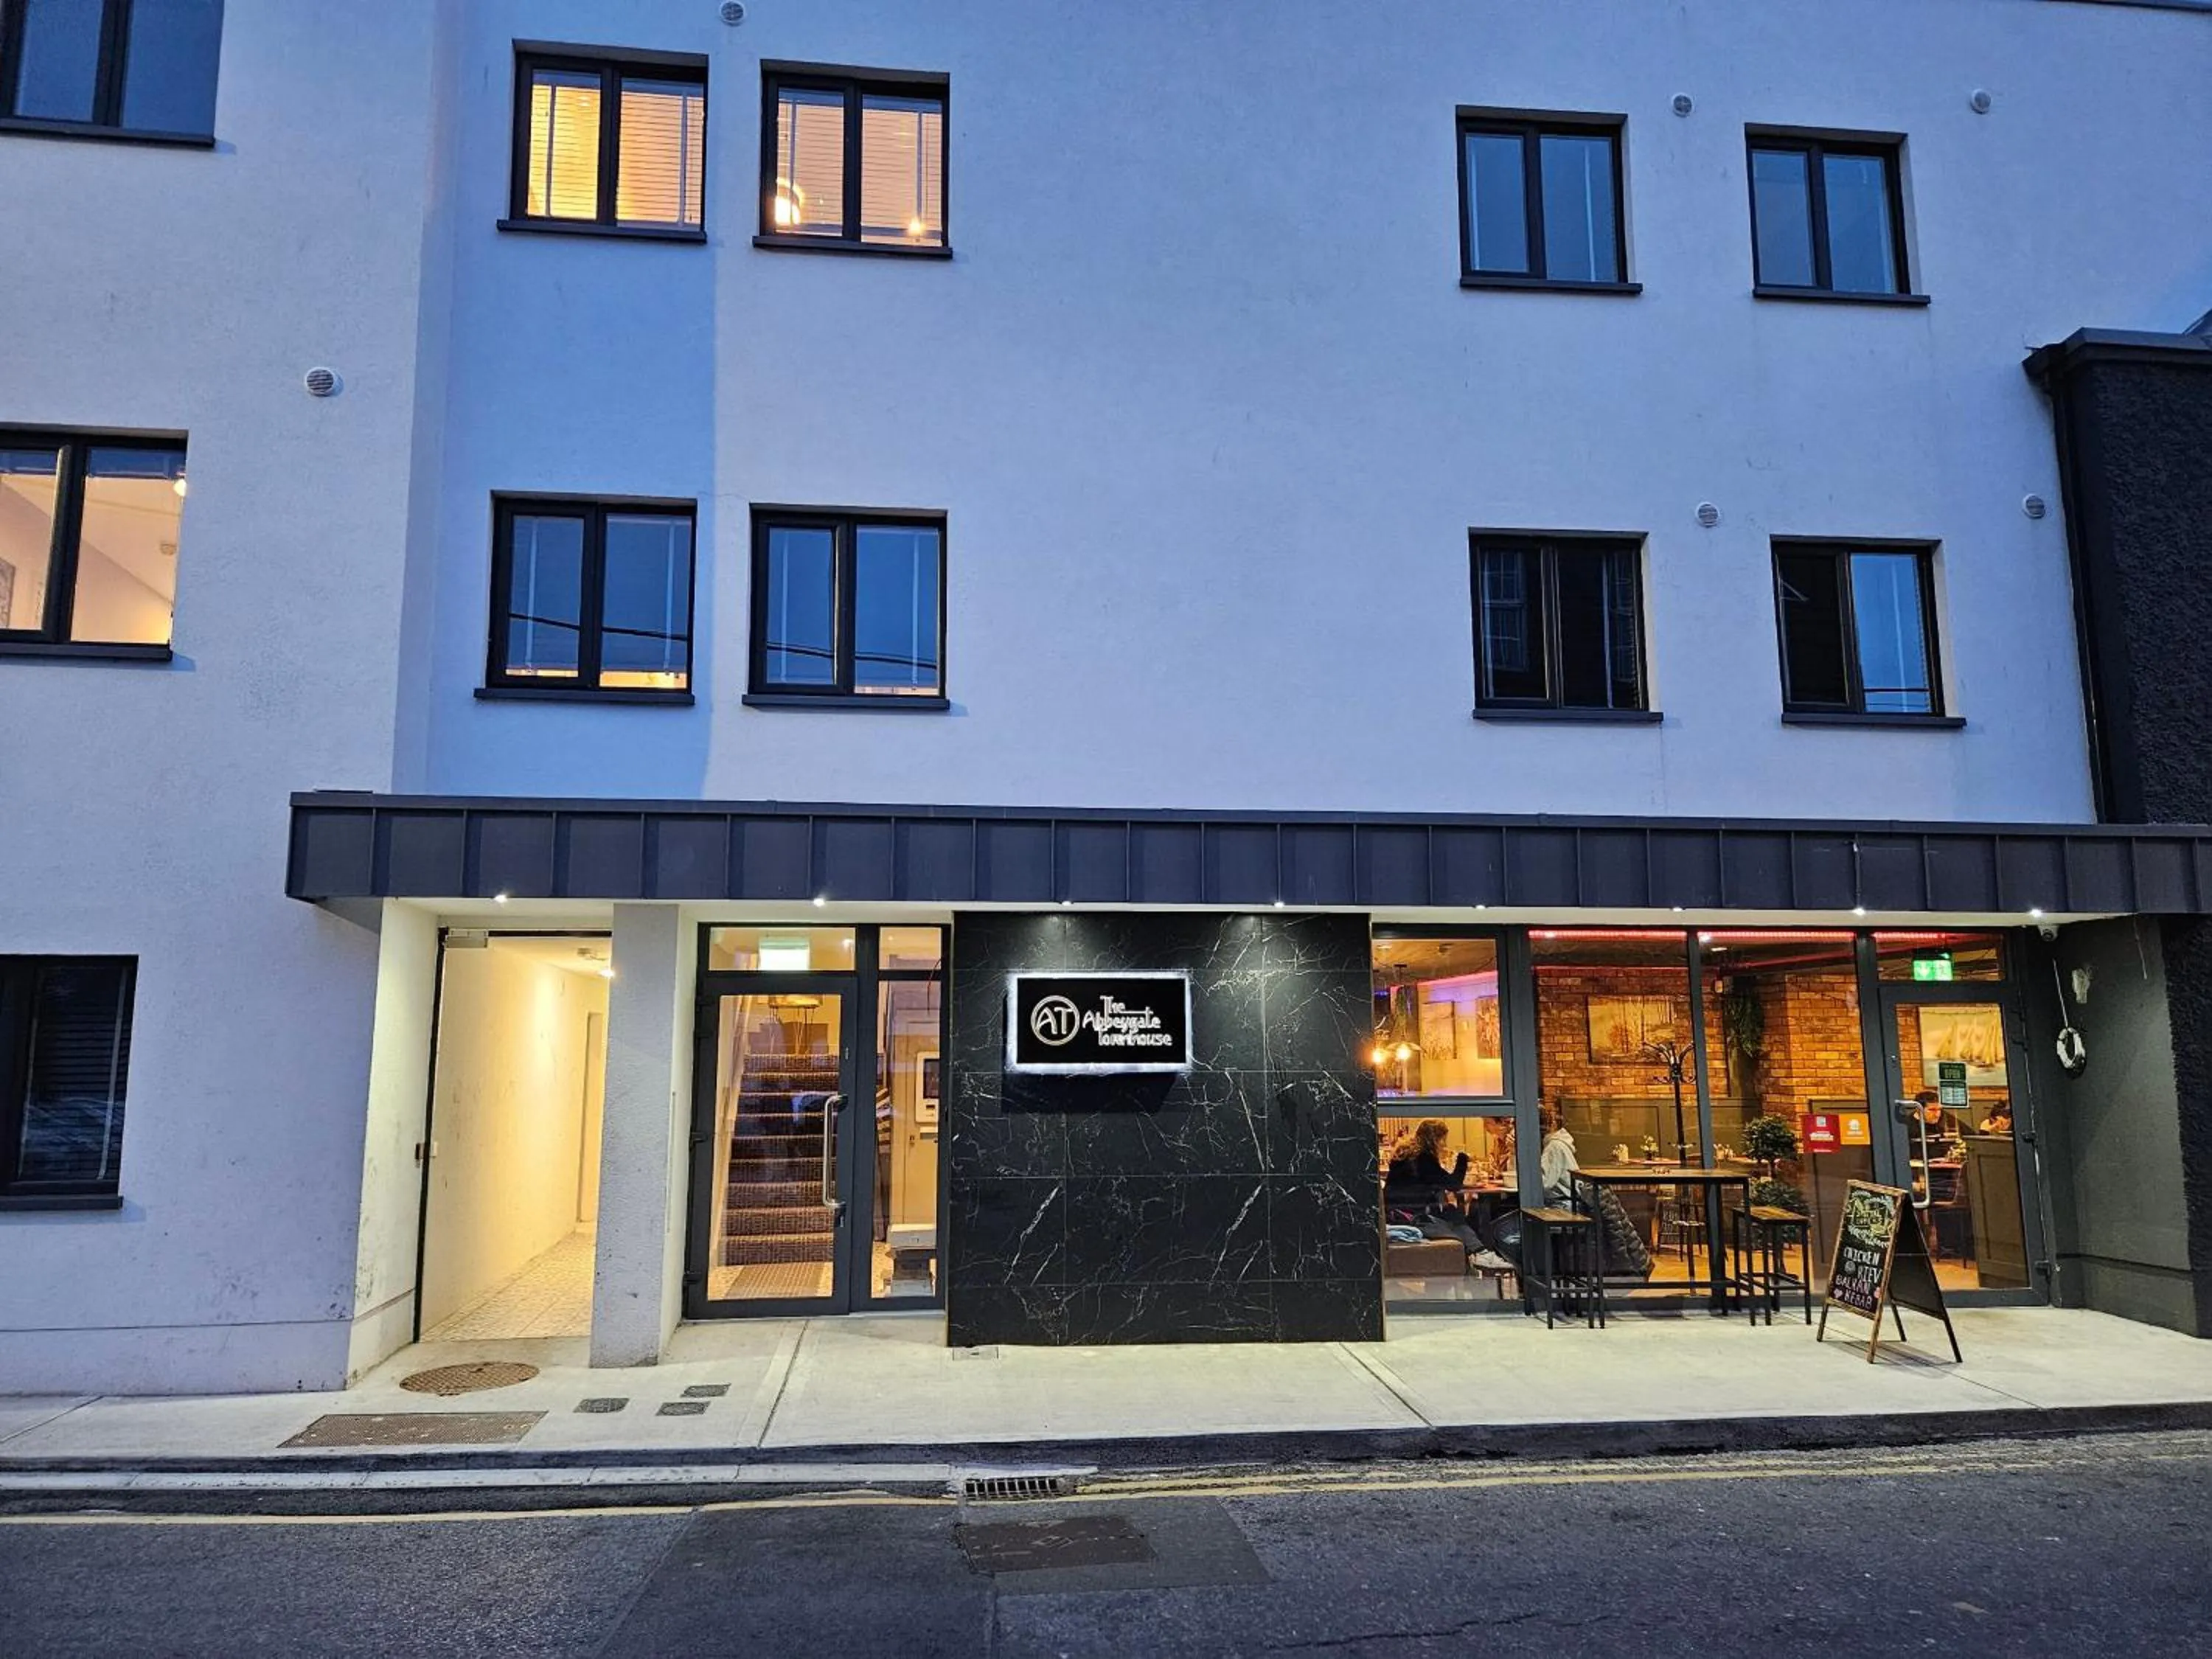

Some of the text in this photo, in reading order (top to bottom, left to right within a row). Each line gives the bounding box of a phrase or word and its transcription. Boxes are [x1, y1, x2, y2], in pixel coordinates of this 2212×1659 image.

[1099, 995, 1126, 1014] The
[1034, 1006, 1074, 1035] AT
[1082, 1006, 1161, 1033] Abbeygate
[1843, 1246, 1881, 1266] CHICKEN
[1857, 1265, 1883, 1284] KIEV
